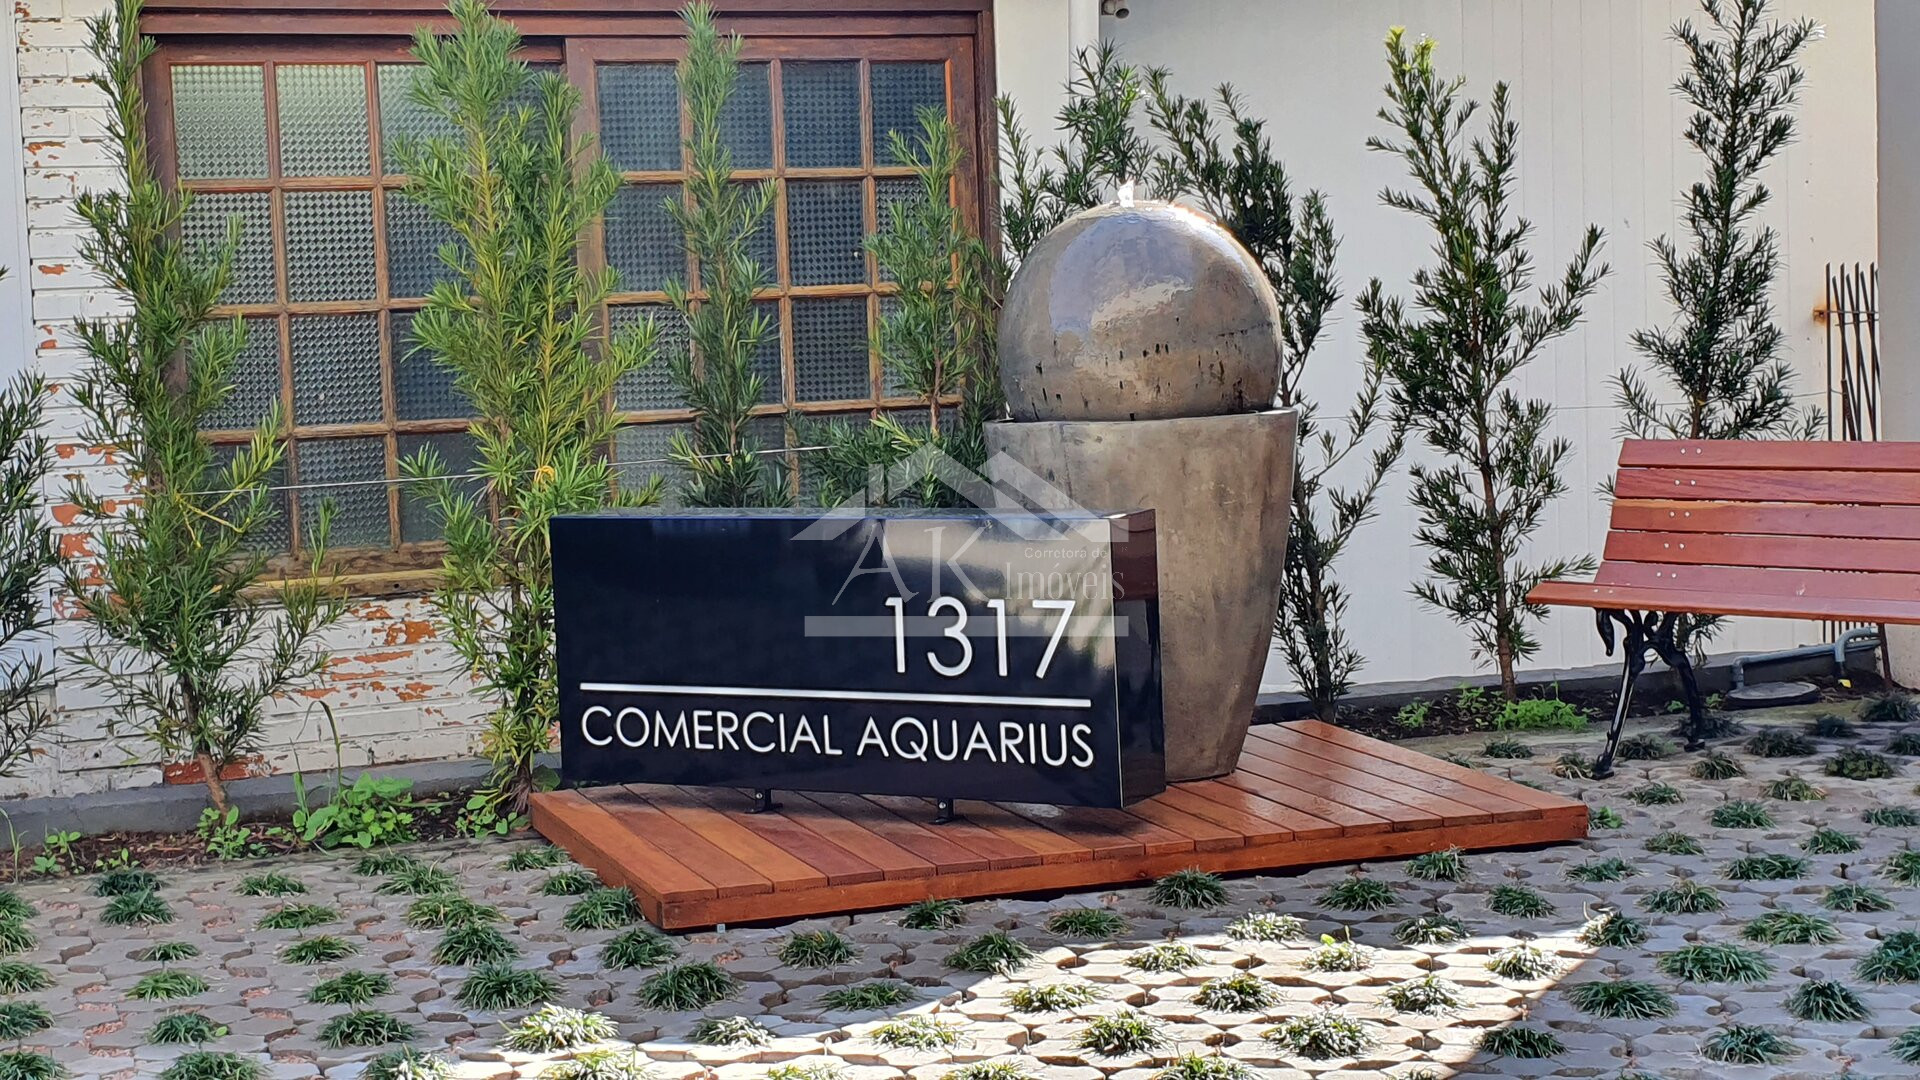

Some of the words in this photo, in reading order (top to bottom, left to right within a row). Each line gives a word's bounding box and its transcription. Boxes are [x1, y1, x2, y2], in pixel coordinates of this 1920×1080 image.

[885, 596, 1076, 679] 1317
[581, 705, 843, 755] COMERCIAL
[856, 715, 1095, 767] AQUARIUS
